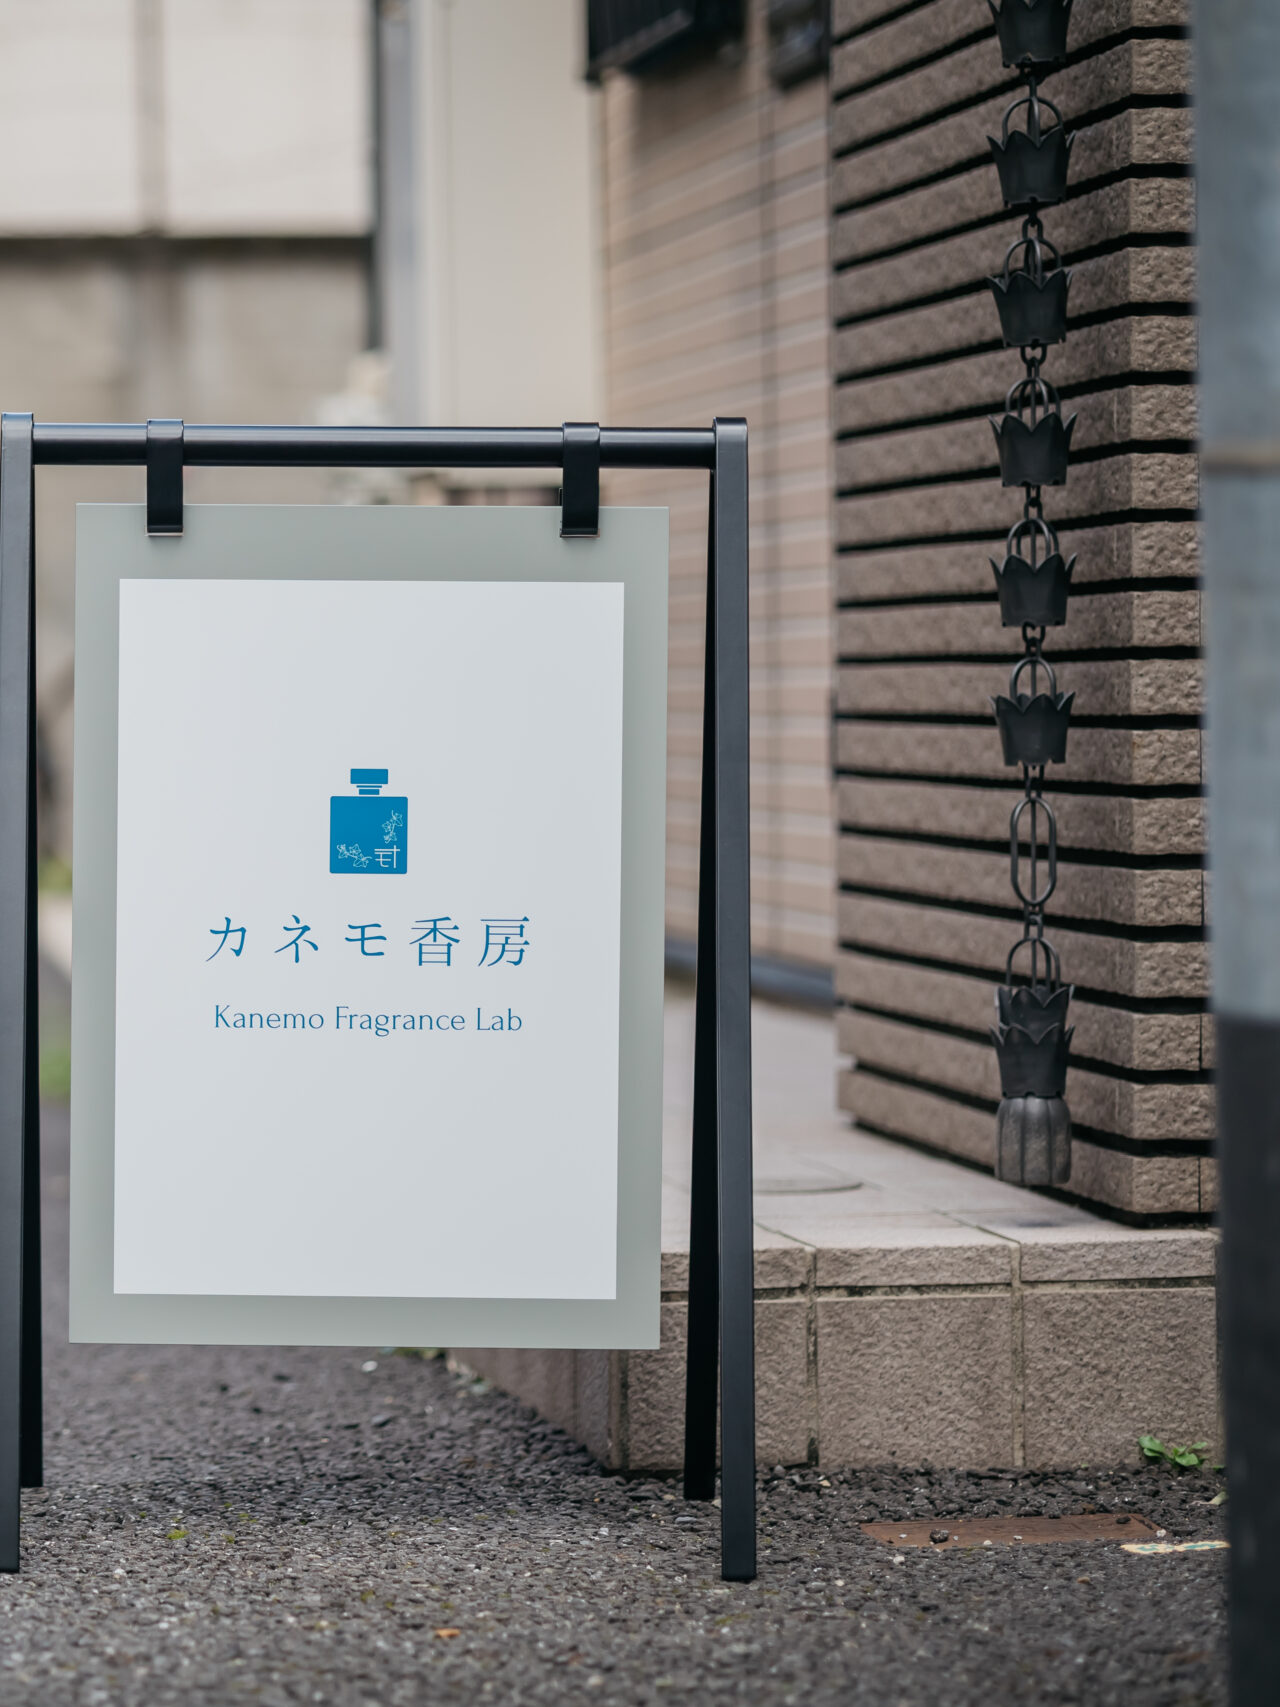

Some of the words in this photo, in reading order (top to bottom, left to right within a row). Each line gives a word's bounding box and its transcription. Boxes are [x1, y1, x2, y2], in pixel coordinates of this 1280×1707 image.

[206, 914, 531, 968] カネモ香房
[214, 1004, 325, 1030] Kanemo
[335, 1005, 466, 1038] Fragrance
[476, 1007, 523, 1032] Lab
